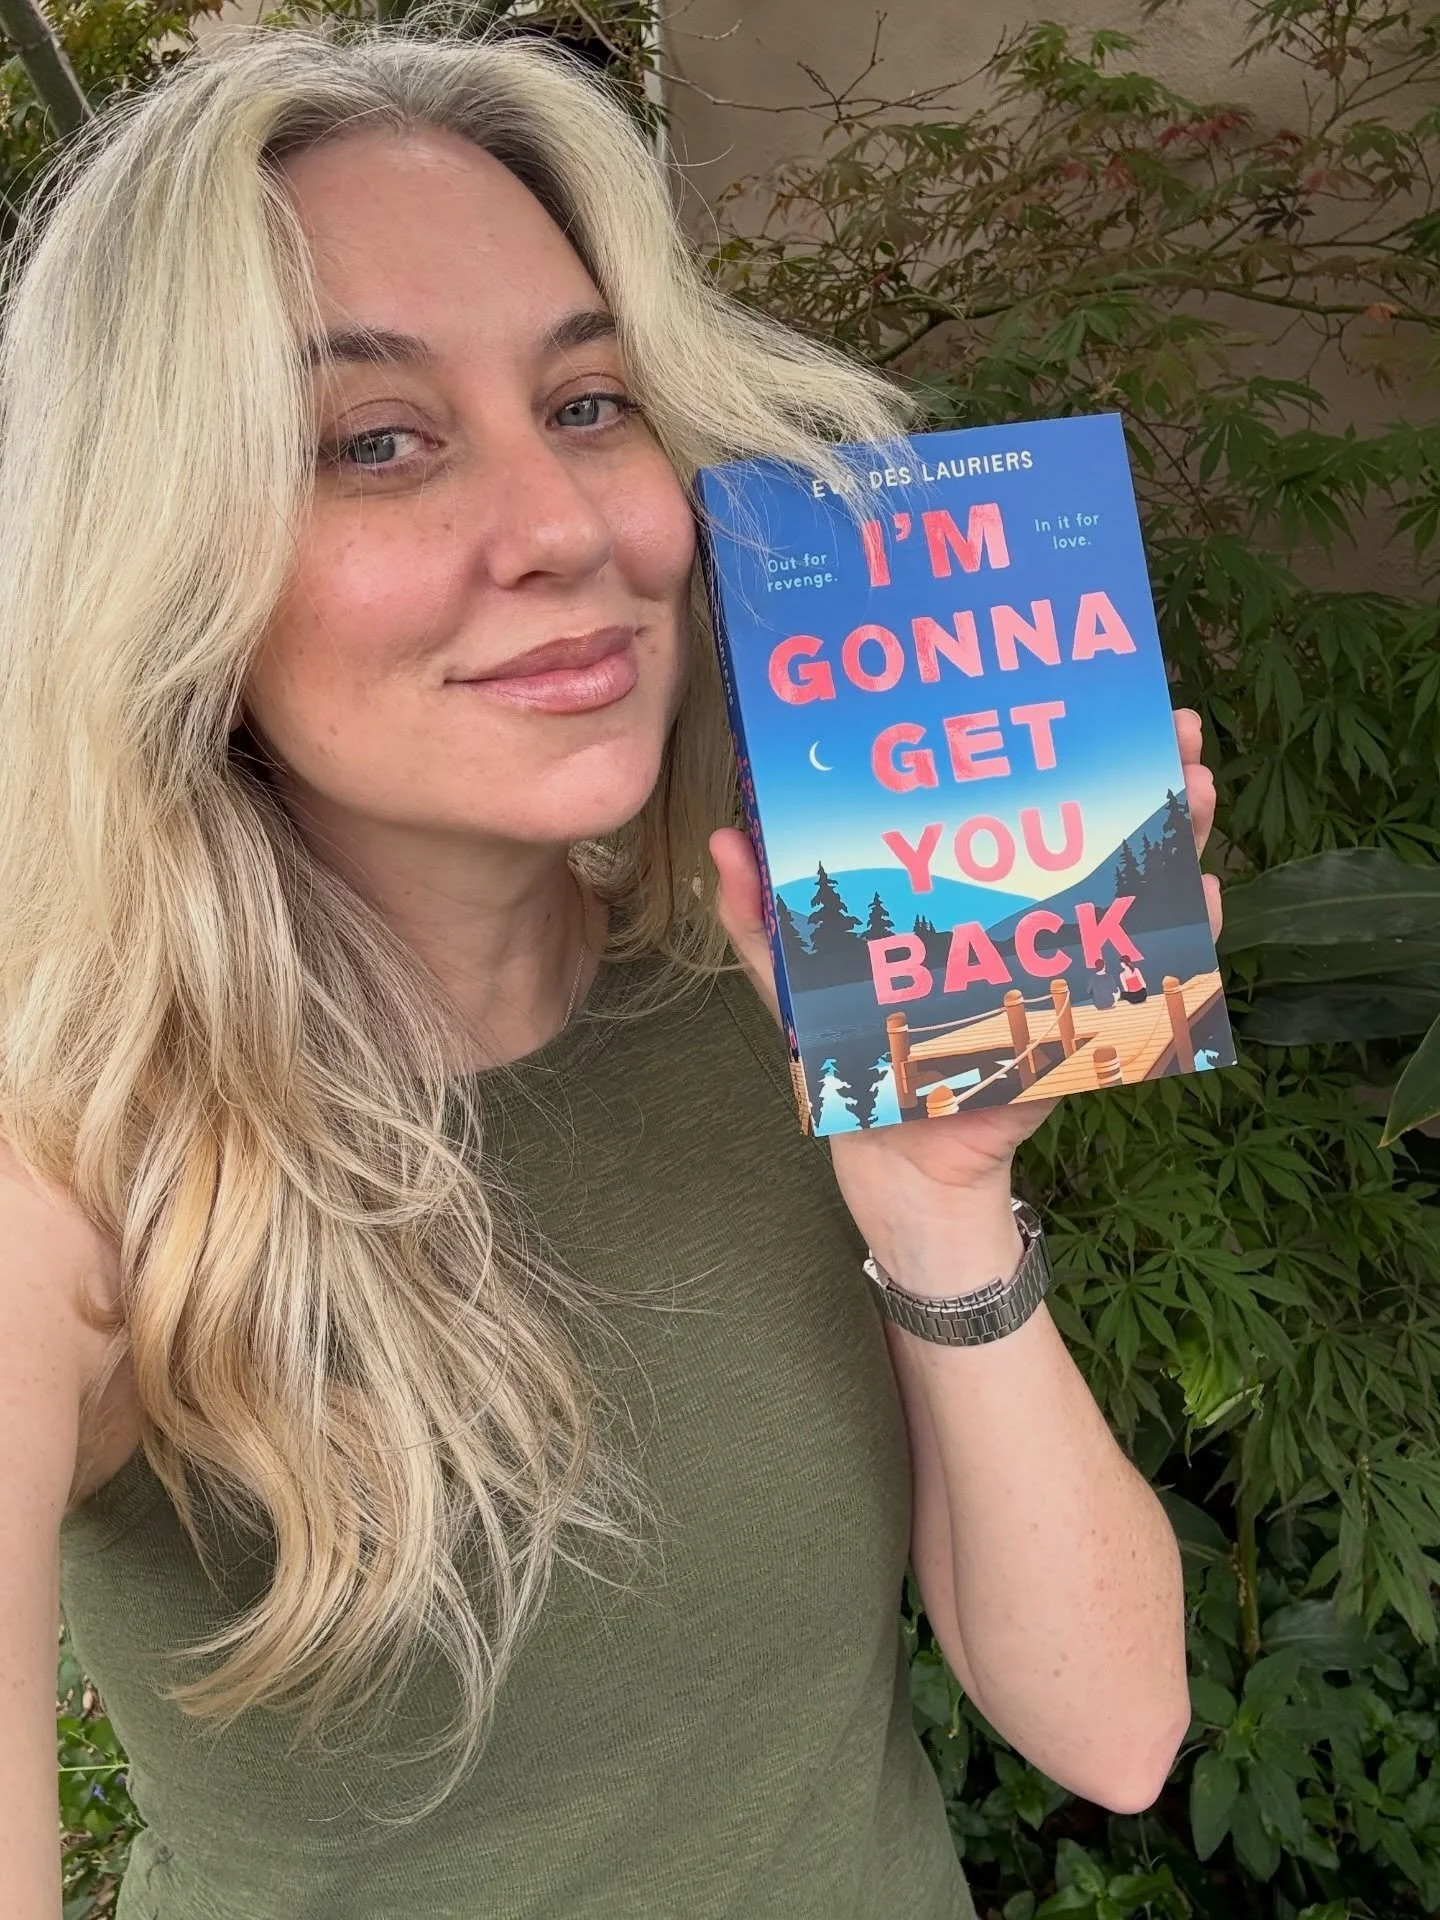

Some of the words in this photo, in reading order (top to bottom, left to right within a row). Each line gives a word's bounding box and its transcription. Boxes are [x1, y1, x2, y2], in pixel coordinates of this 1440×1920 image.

[869, 466, 912, 489] DES
[922, 450, 1034, 482] LAURIERS
[861, 502, 1011, 588] I'M
[1034, 519, 1052, 533] In
[1058, 516, 1071, 532] it
[1075, 513, 1100, 528] for
[1052, 533, 1092, 550] love.
[767, 556, 799, 574] Out
[803, 553, 828, 567] for
[767, 575, 838, 593] revenge.
[767, 590, 1137, 705] GONNA
[871, 701, 1067, 792] GET
[880, 800, 1085, 895] YOU
[867, 895, 1145, 1005] BACK
